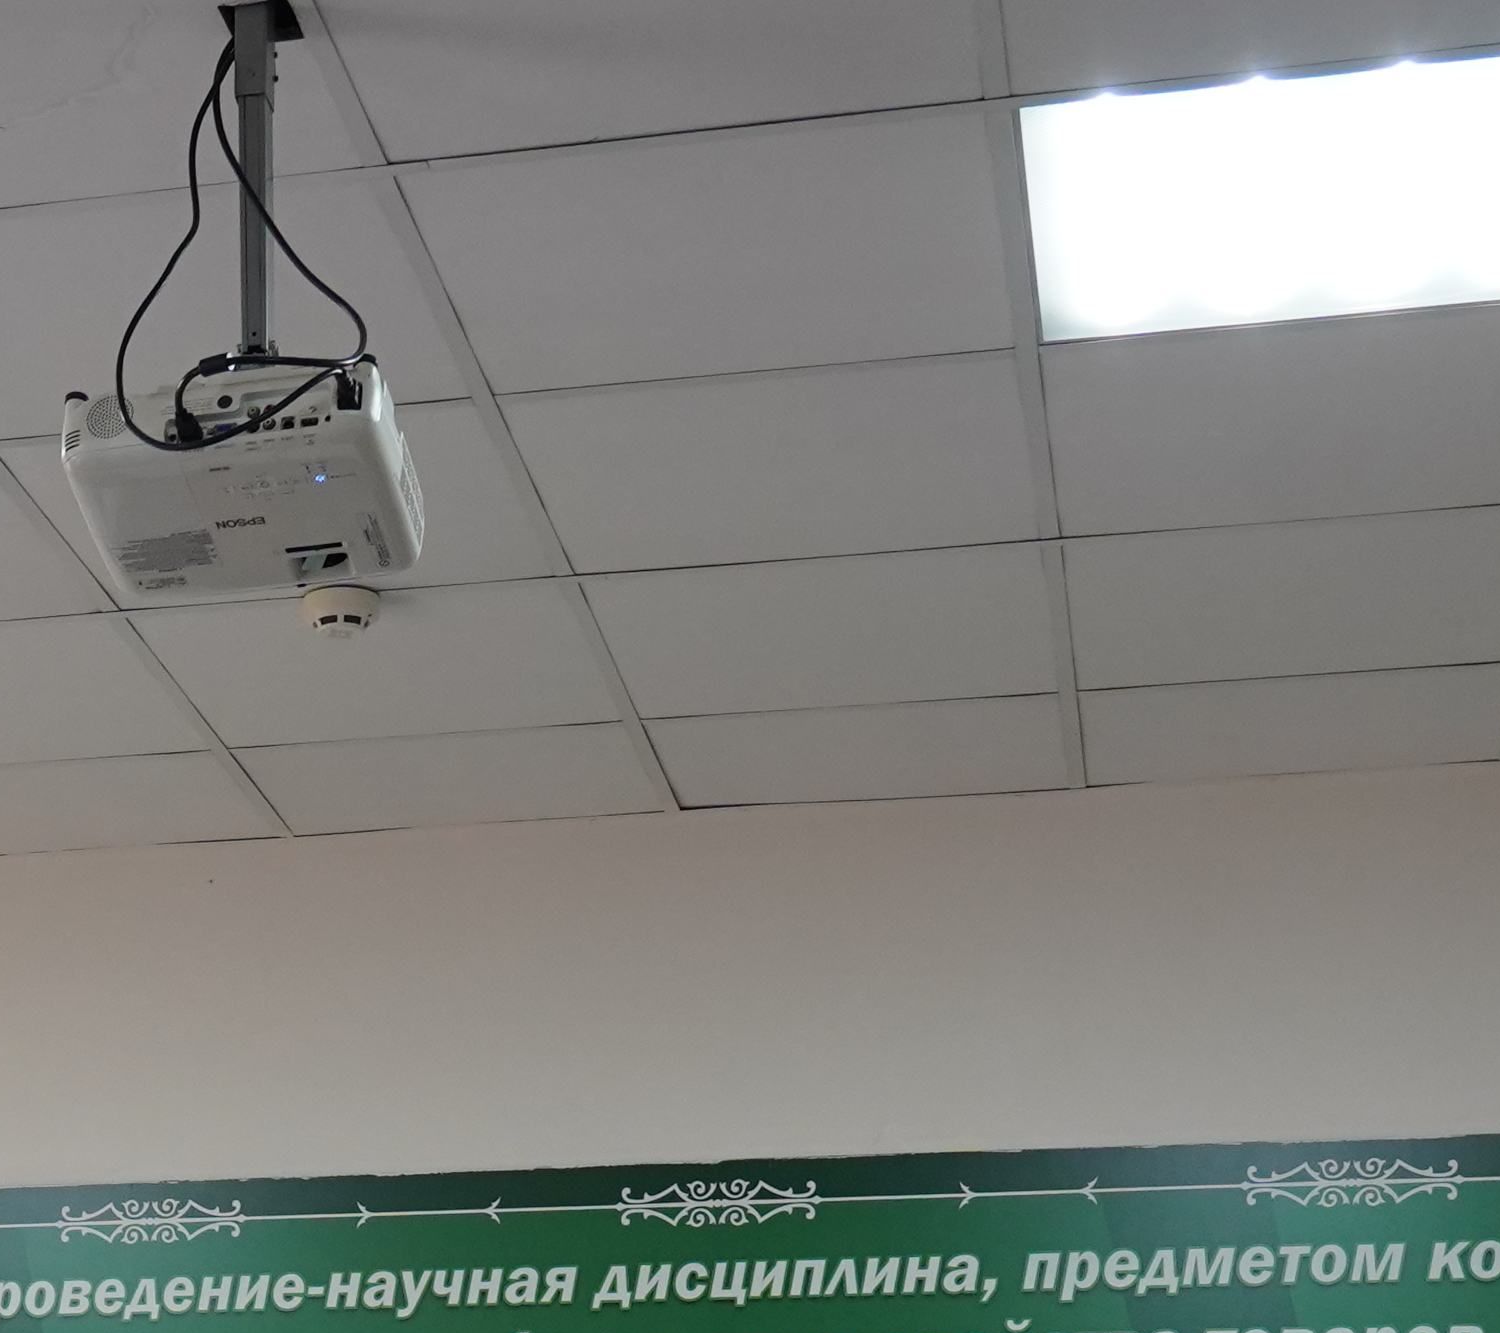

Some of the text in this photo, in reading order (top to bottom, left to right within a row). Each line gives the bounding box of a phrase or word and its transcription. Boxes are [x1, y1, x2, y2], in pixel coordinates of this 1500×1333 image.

[215, 516, 266, 530] EPSON
[591, 1254, 998, 1309] дисциплина,
[1022, 1242, 1405, 1301] предметом
